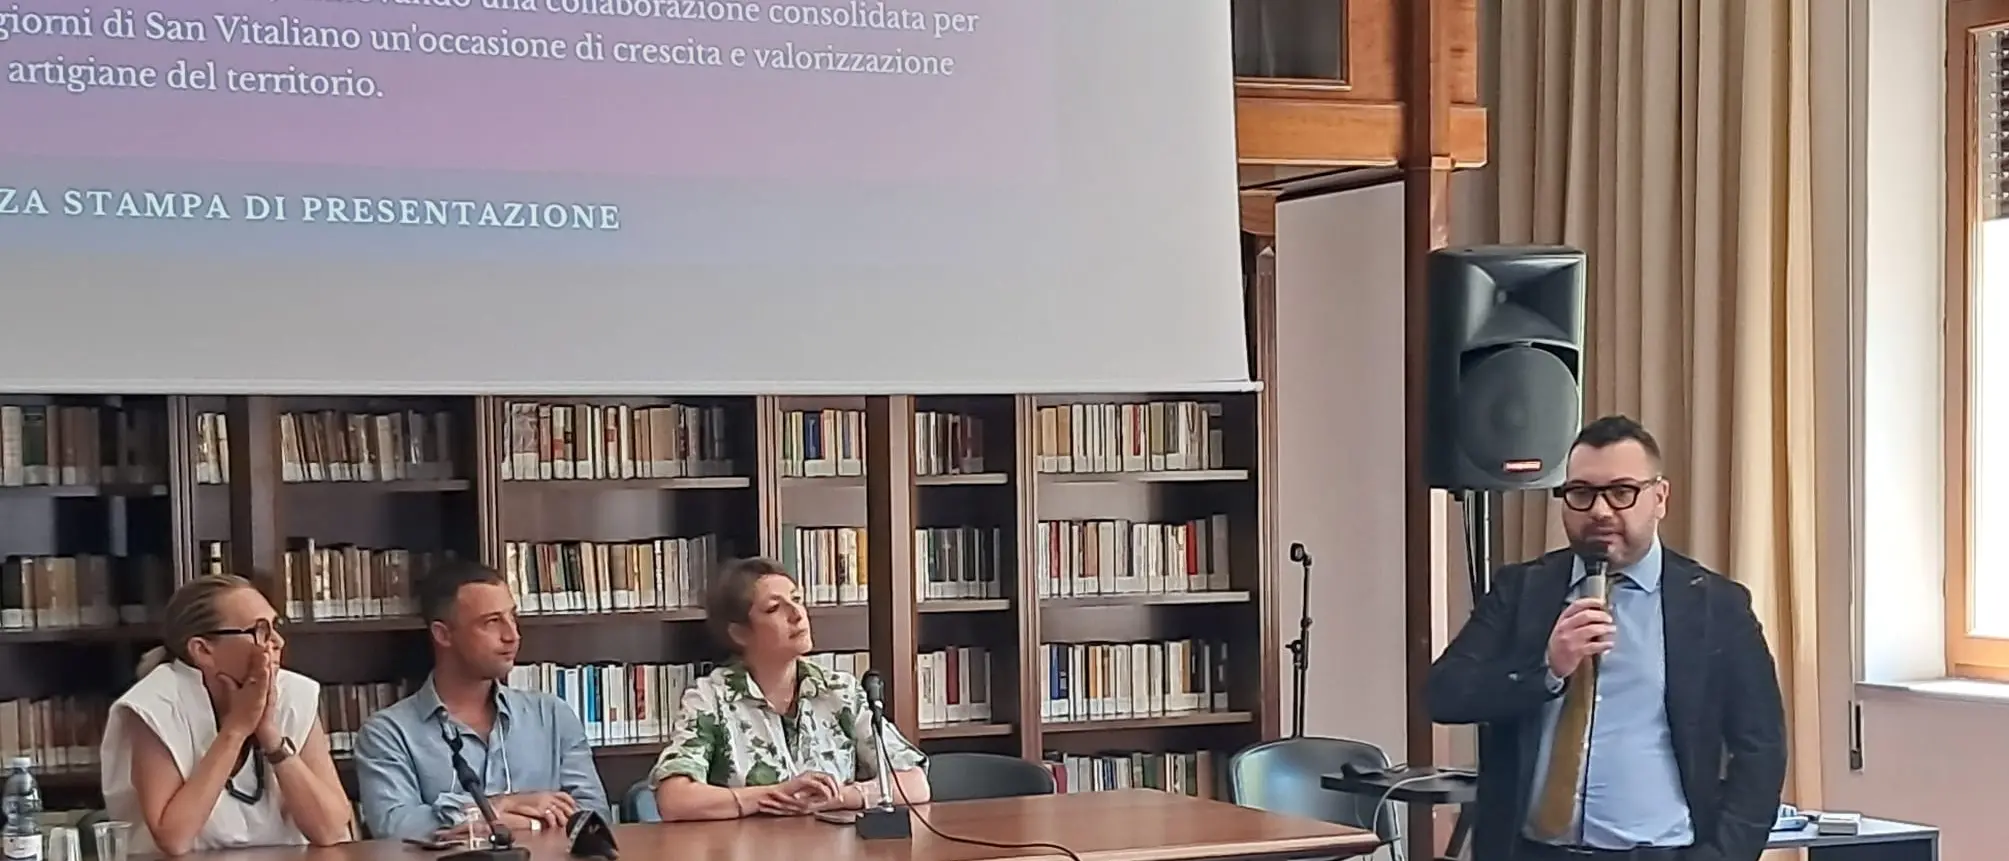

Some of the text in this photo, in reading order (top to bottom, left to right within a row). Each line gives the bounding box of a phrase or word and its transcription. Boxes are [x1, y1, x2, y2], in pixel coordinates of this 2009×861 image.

[546, 0, 760, 22] collaborazione
[769, 0, 927, 30] consolidata
[933, 12, 980, 39] per
[103, 8, 136, 38] di
[145, 11, 206, 41] San
[213, 14, 361, 49] Vitaliano
[370, 23, 567, 59] un'occasione
[575, 32, 605, 61] di
[613, 37, 723, 66] crescita
[730, 48, 746, 67] e
[753, 42, 955, 76] valorizzazione
[8, 55, 384, 97] artigiane del territorio.
[63, 190, 231, 219] STAMPA
[244, 194, 287, 221] DI
[301, 196, 620, 229] PRESENTAZIONE
